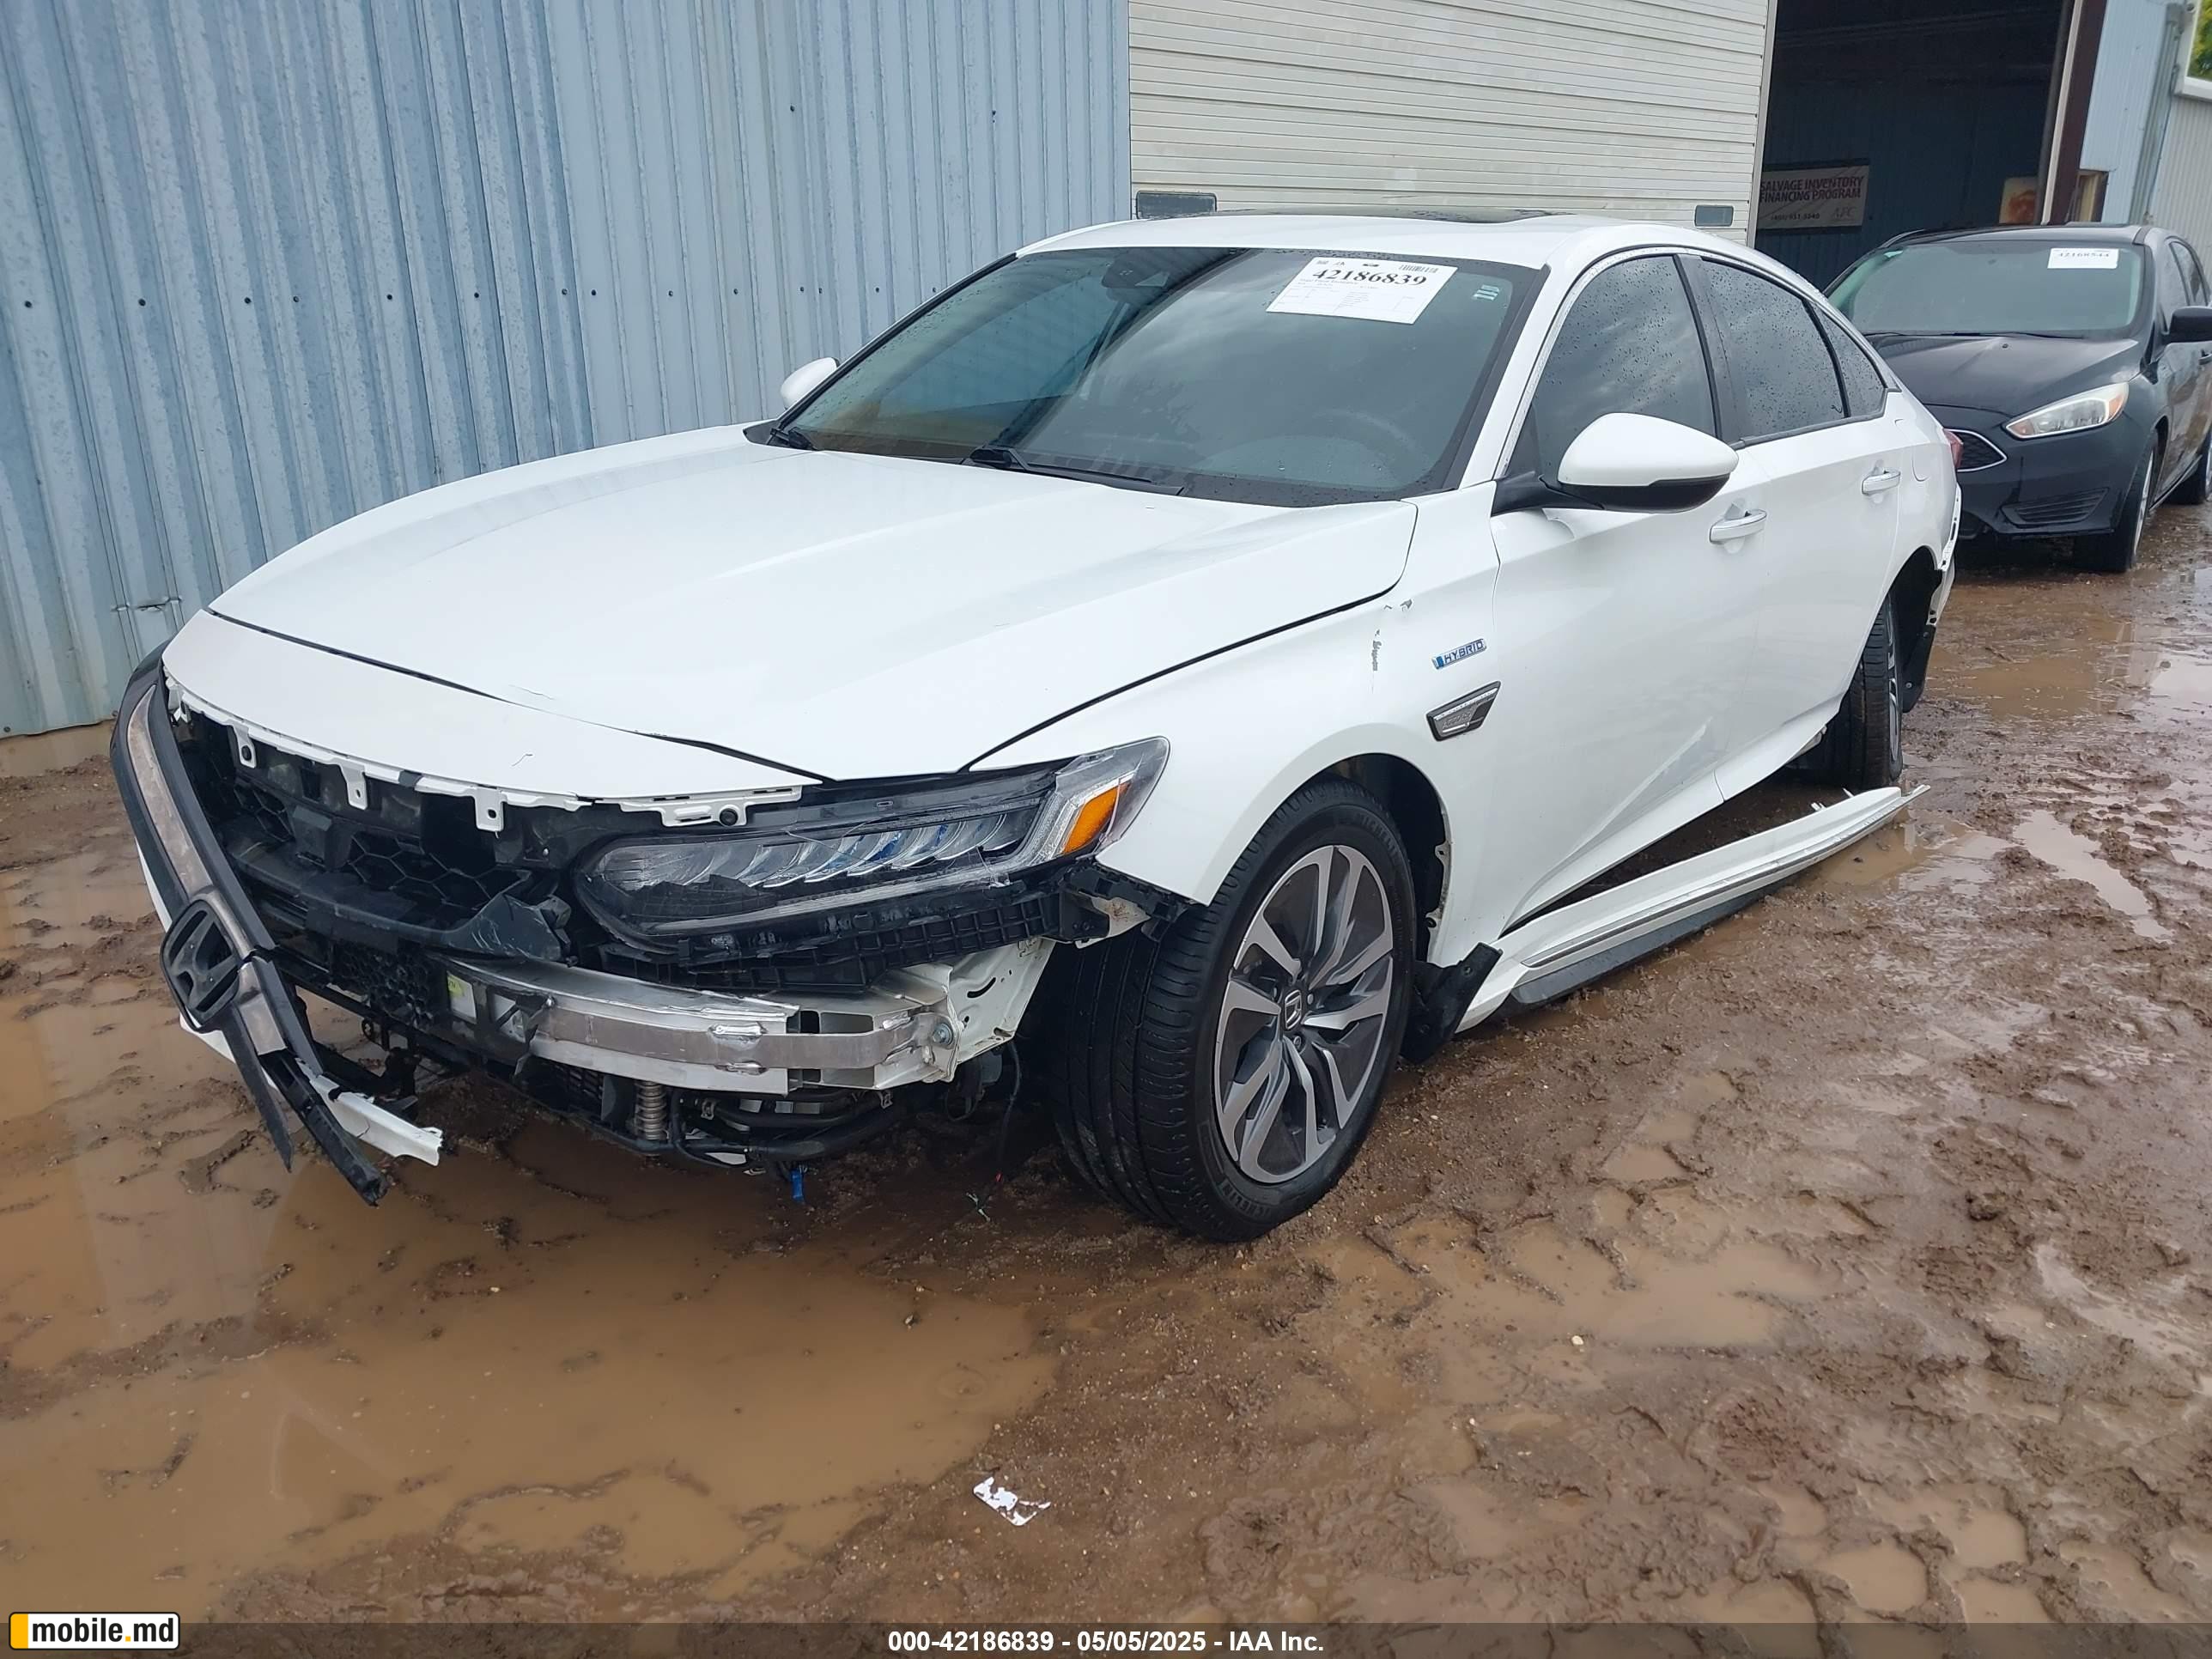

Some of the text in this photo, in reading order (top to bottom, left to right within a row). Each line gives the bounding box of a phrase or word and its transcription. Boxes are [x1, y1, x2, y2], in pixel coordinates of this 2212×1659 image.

[1760, 175, 1864, 191] SALVAGE INVENTORY
[1760, 187, 1861, 203] FINANCING PROGRAM
[1313, 268, 1427, 287] 42186839
[1444, 641, 1484, 664] HYBRID
